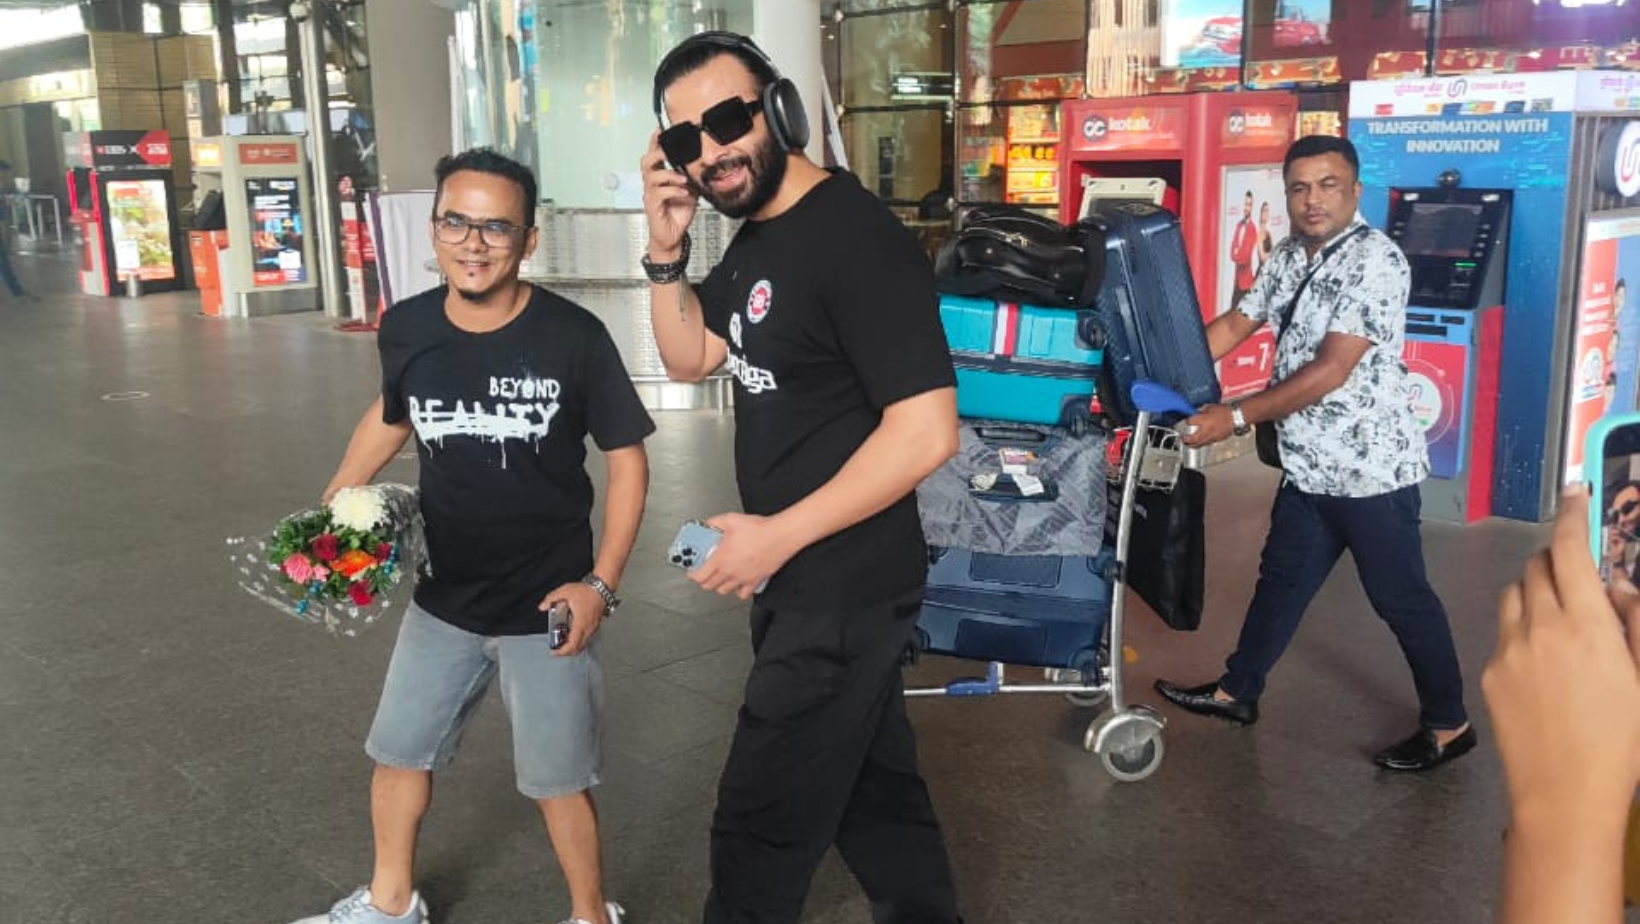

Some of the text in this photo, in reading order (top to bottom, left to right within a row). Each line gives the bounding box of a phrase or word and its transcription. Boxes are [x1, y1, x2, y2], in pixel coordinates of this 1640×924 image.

[1108, 116, 1150, 131] kotak
[1367, 118, 1549, 135] TRANSFORMATION WITH
[1406, 139, 1500, 153] INNOVATION
[489, 376, 561, 399] BEYOND
